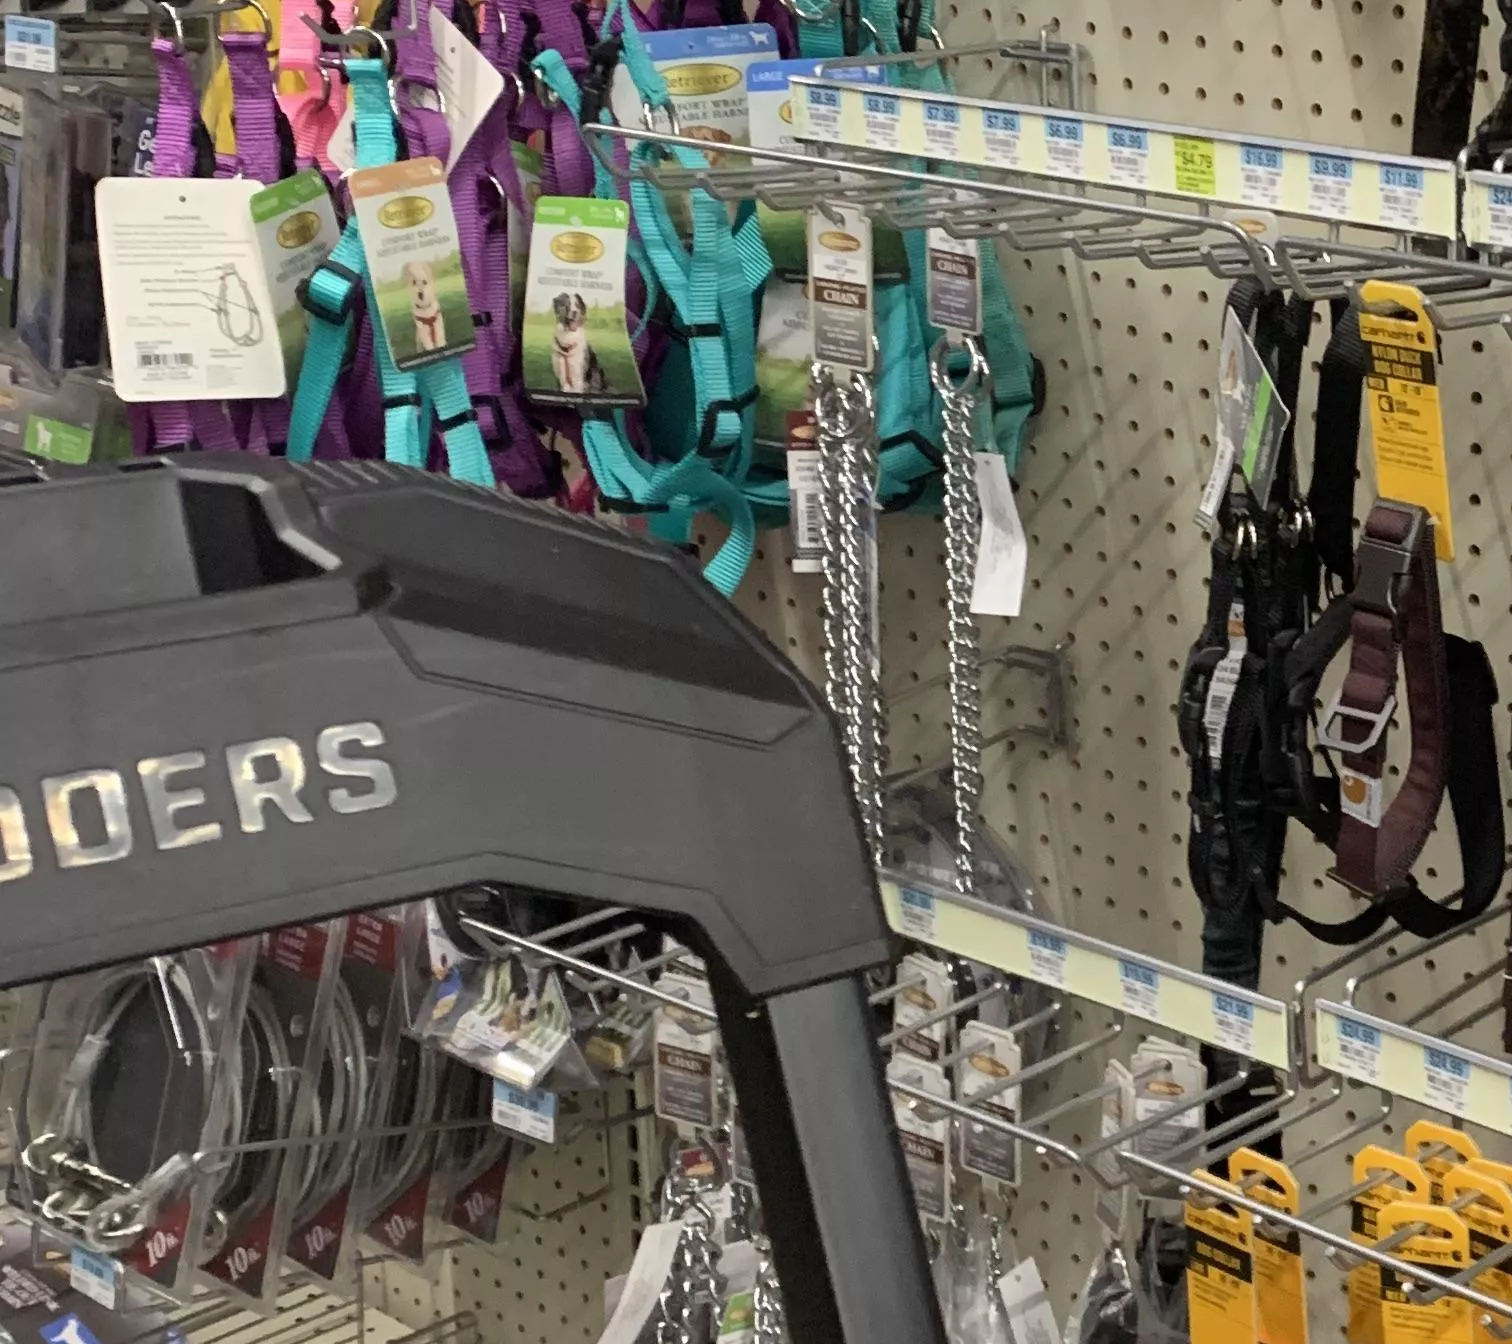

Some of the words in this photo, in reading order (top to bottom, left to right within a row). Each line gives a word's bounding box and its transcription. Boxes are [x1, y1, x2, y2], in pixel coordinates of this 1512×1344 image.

[751, 71, 784, 83] LARGE
[822, 288, 860, 306] CHAIN
[1361, 324, 1416, 341] carhartt
[1397, 363, 1423, 381] COLLAR
